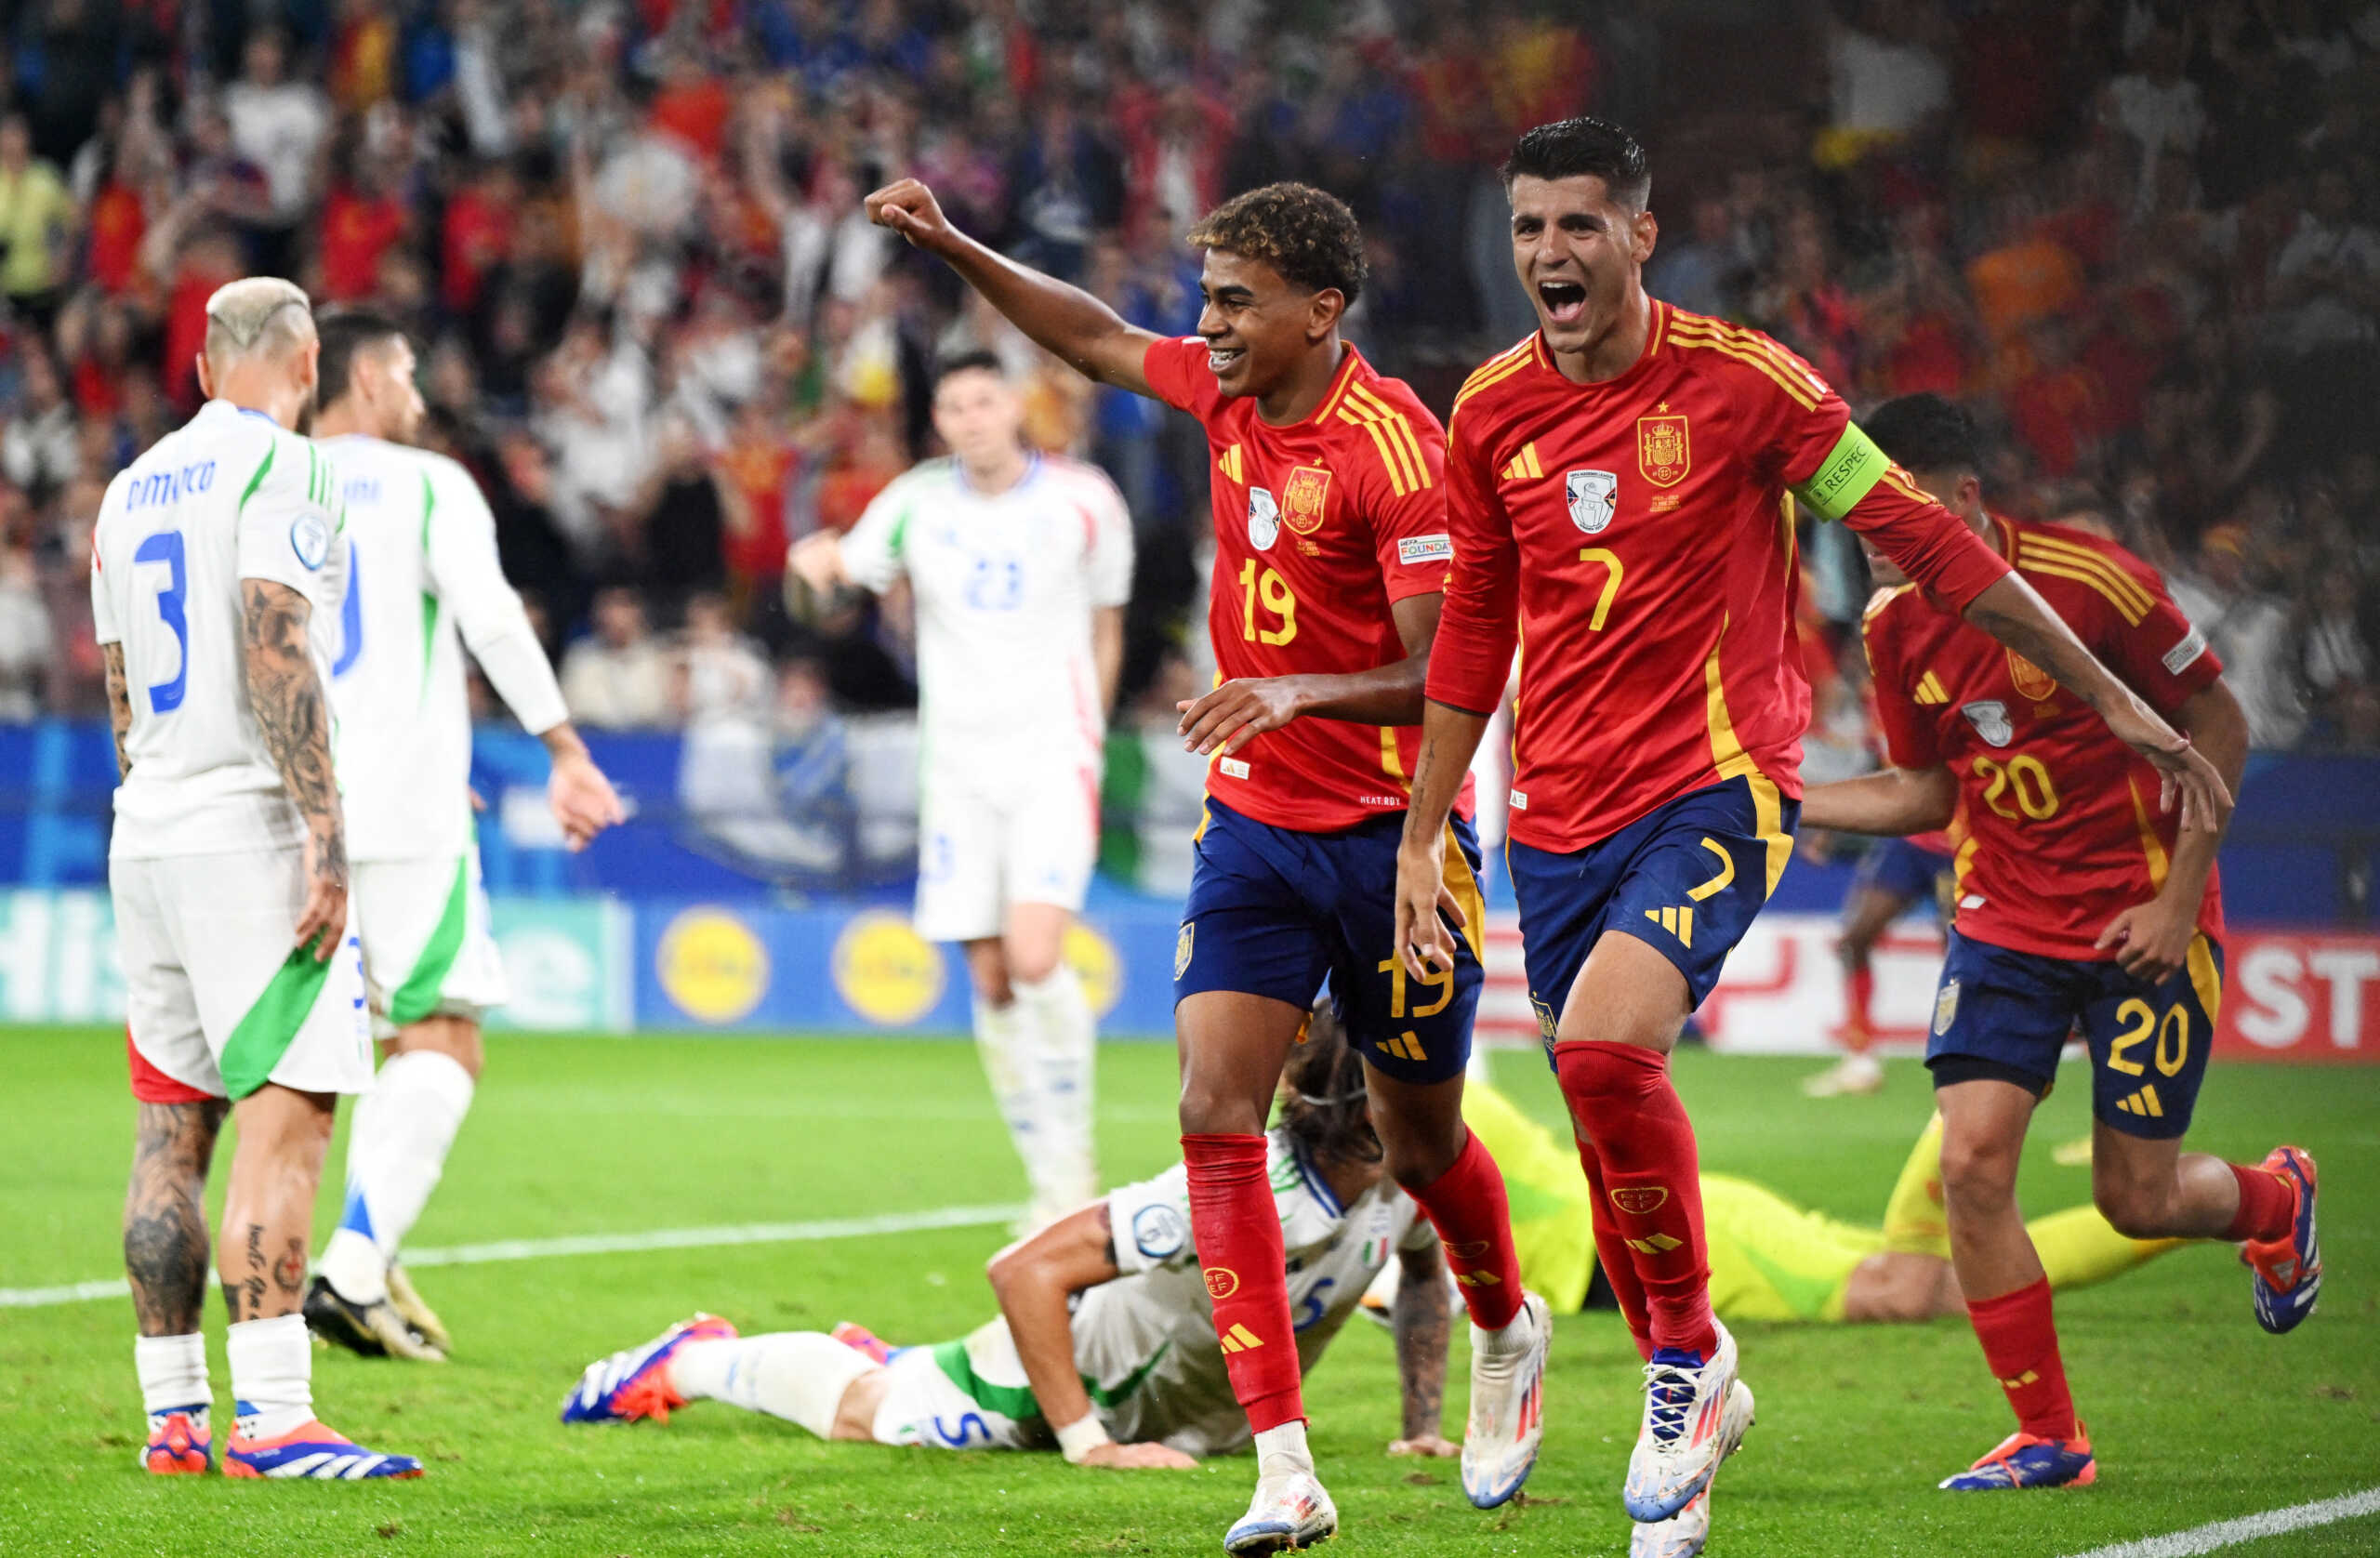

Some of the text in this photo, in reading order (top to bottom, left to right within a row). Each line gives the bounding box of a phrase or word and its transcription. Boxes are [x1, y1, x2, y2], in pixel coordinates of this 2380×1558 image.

[1824, 441, 1868, 492] RESPEC
[134, 531, 189, 713] 3
[1239, 558, 1298, 647] 19
[1580, 548, 1624, 631] 7
[1972, 755, 2059, 820] 20
[1686, 837, 1735, 903] 7
[1378, 945, 1454, 1018] 19
[2107, 998, 2188, 1077] 20
